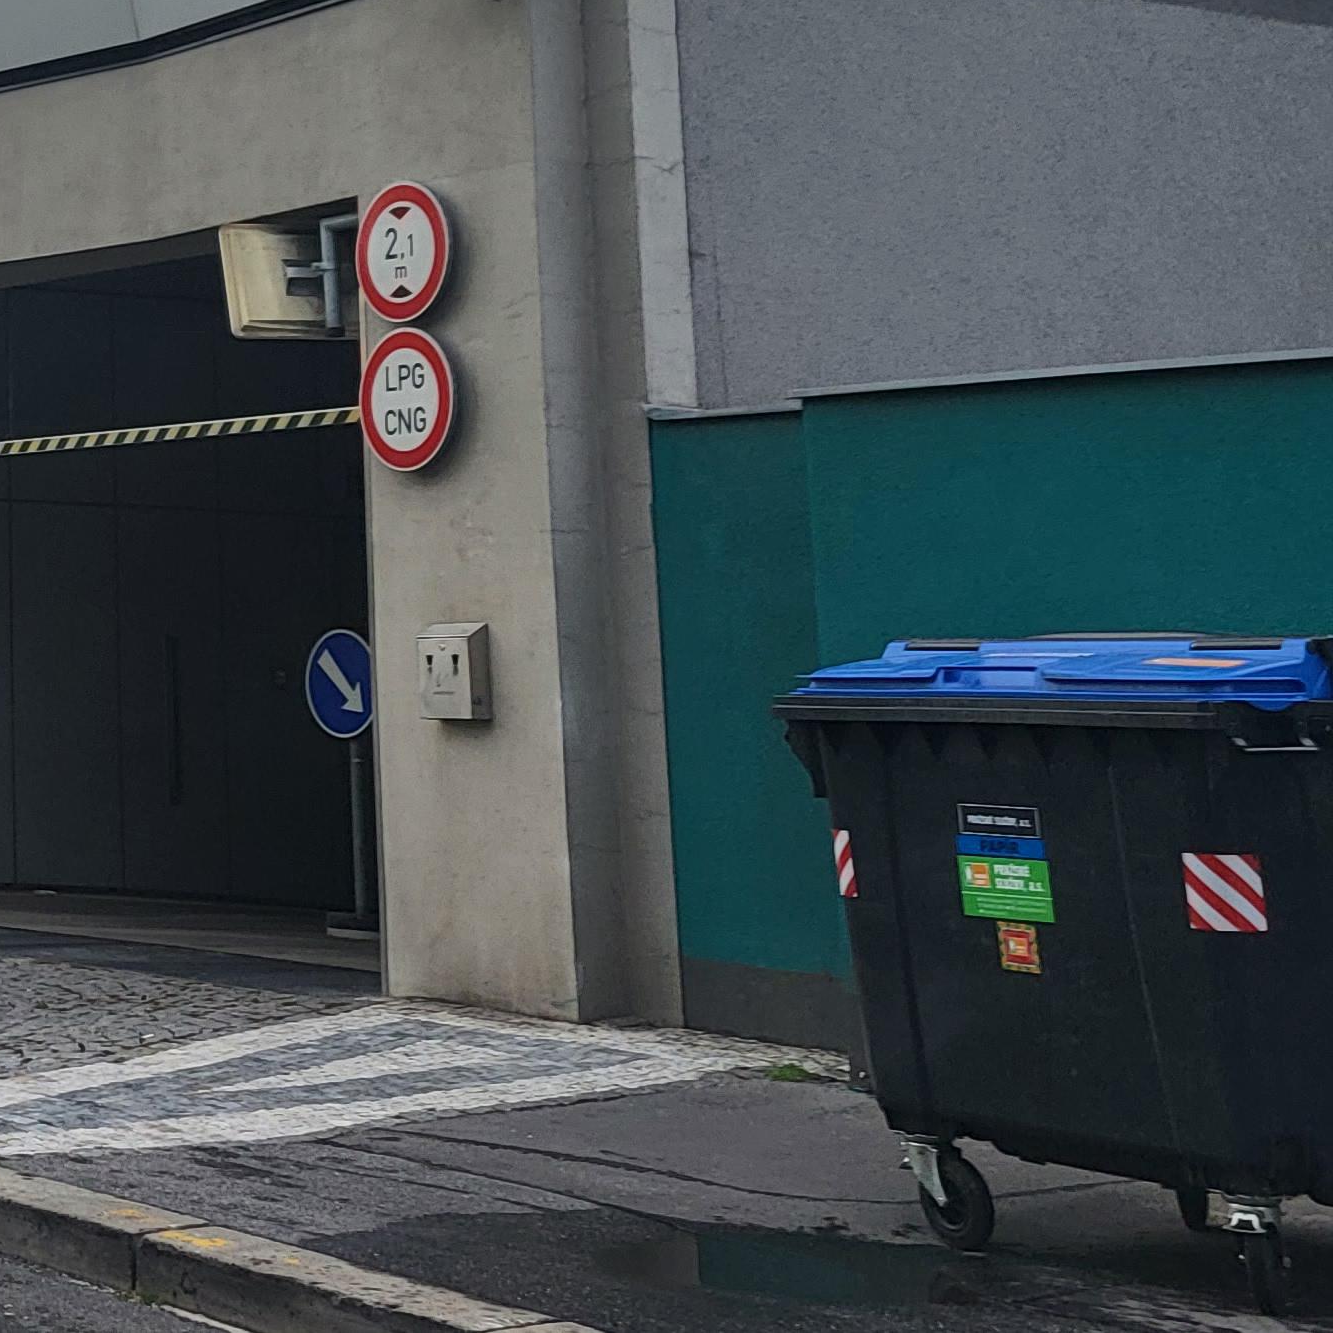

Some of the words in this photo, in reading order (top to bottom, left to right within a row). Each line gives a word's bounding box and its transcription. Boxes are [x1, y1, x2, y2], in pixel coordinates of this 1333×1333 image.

[384, 227, 414, 260] 2,1
[394, 266, 408, 279] m
[385, 363, 425, 392] LPG
[384, 407, 427, 436] CNG
